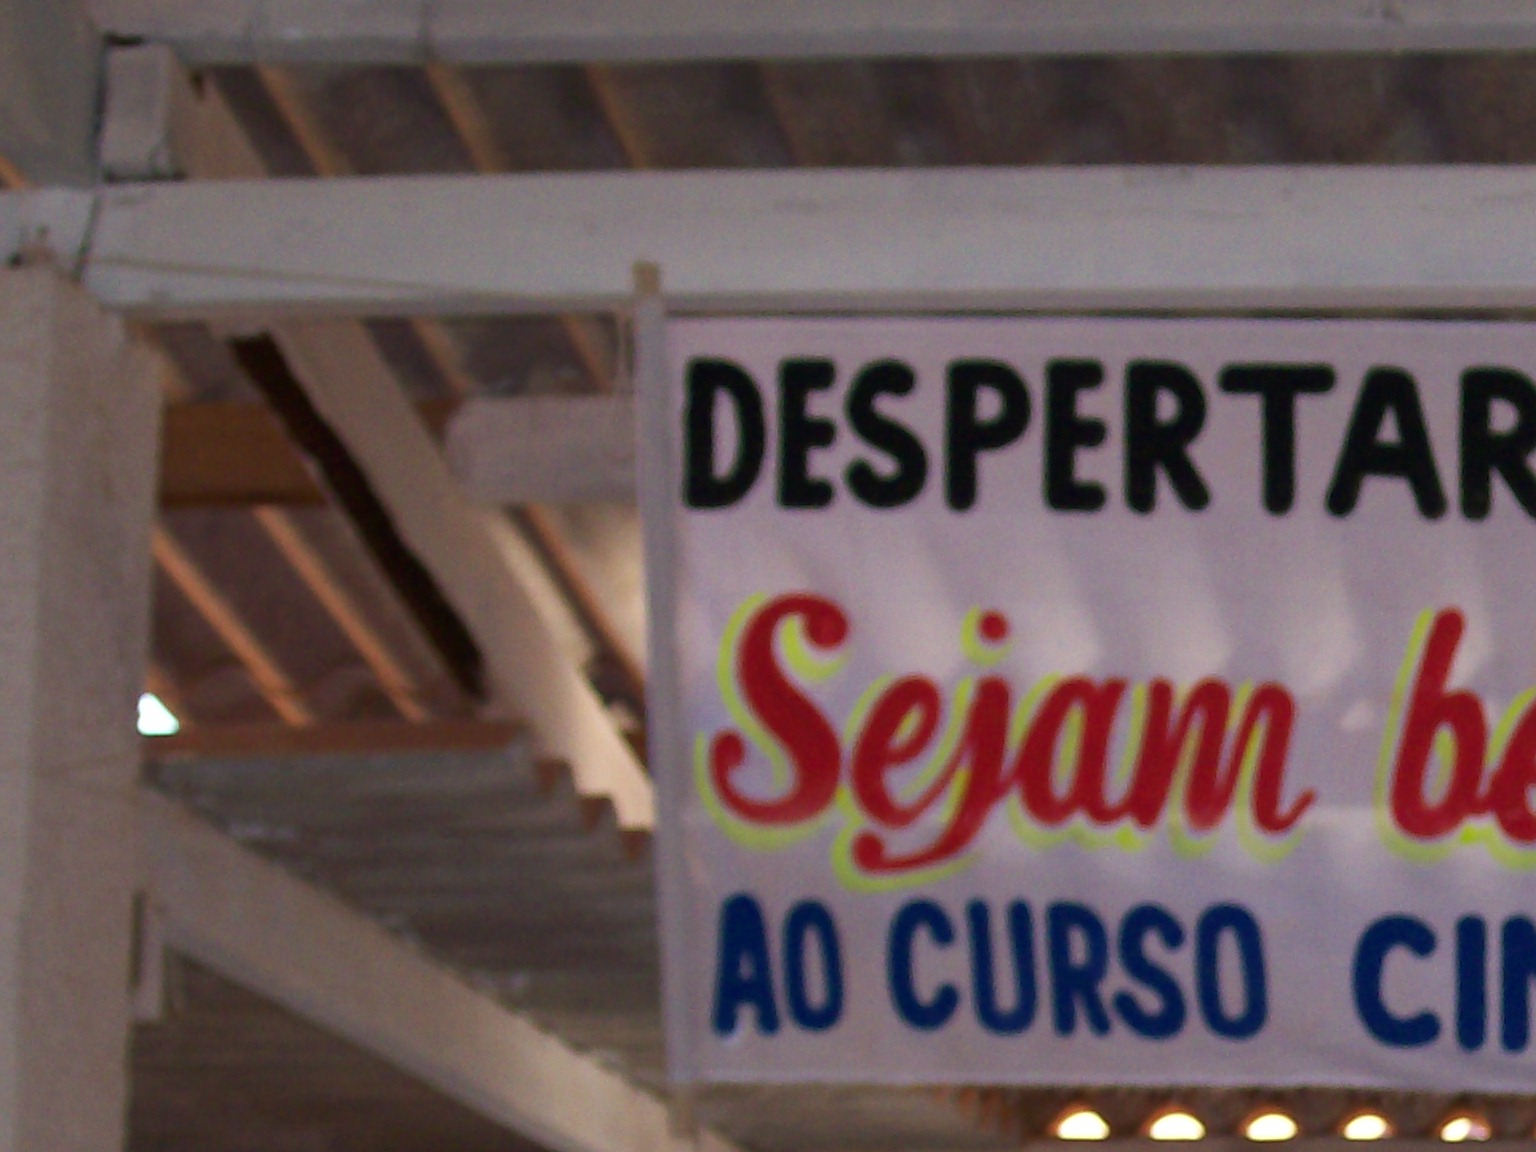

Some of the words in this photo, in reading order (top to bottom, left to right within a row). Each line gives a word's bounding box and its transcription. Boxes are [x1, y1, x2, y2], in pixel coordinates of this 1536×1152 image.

[696, 592, 1318, 886] Sejam
[712, 893, 844, 1036] AO
[886, 898, 1269, 1040] CURSO
